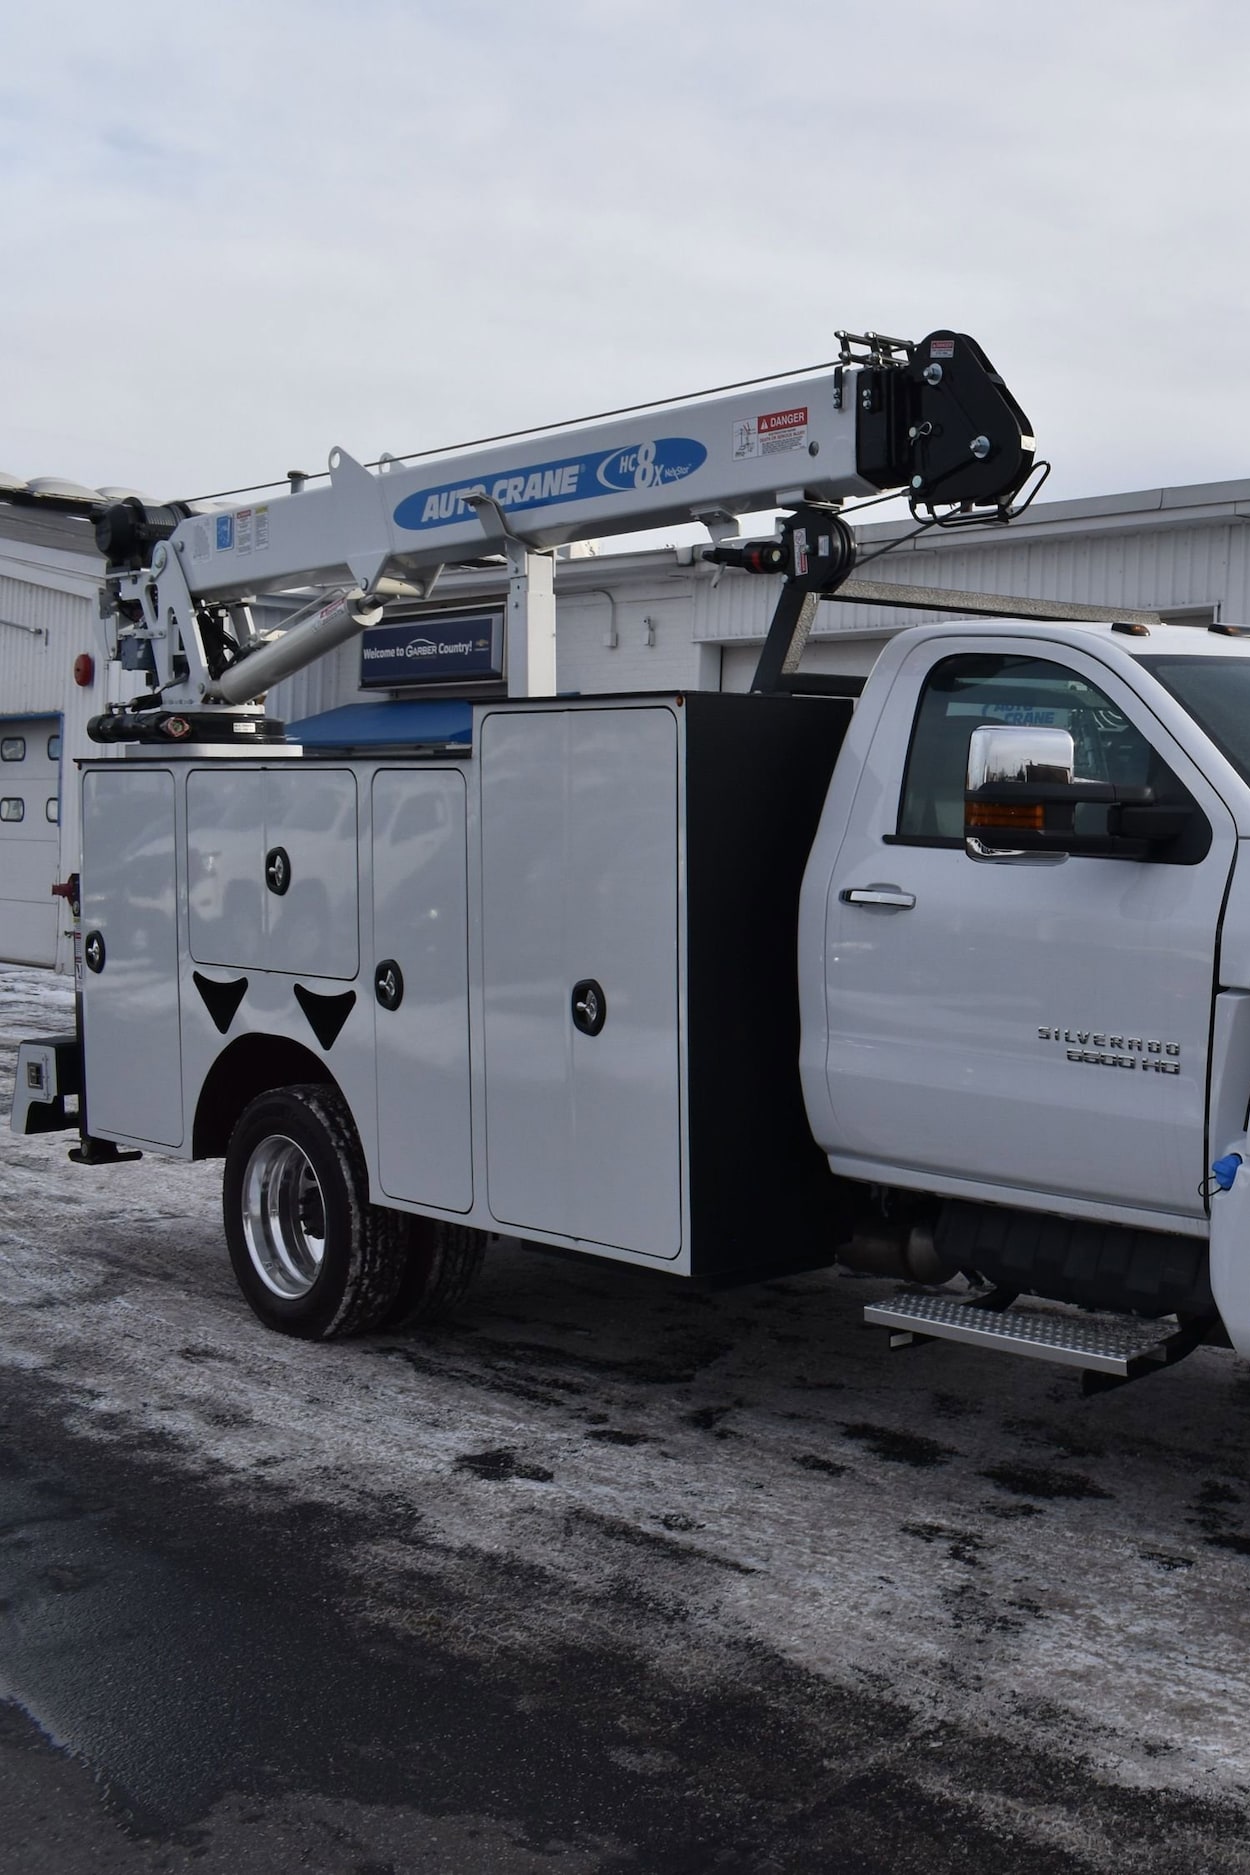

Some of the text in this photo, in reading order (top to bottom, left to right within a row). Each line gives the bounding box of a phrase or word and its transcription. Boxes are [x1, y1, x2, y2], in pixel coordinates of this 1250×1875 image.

[770, 411, 805, 427] DANGER
[492, 464, 580, 505] CRANE
[363, 640, 473, 660] Welcome to GARBER Country!
[1004, 712, 1055, 724] CRANE
[1038, 1026, 1181, 1056] SILVERADO
[1142, 1057, 1181, 1075] HD
